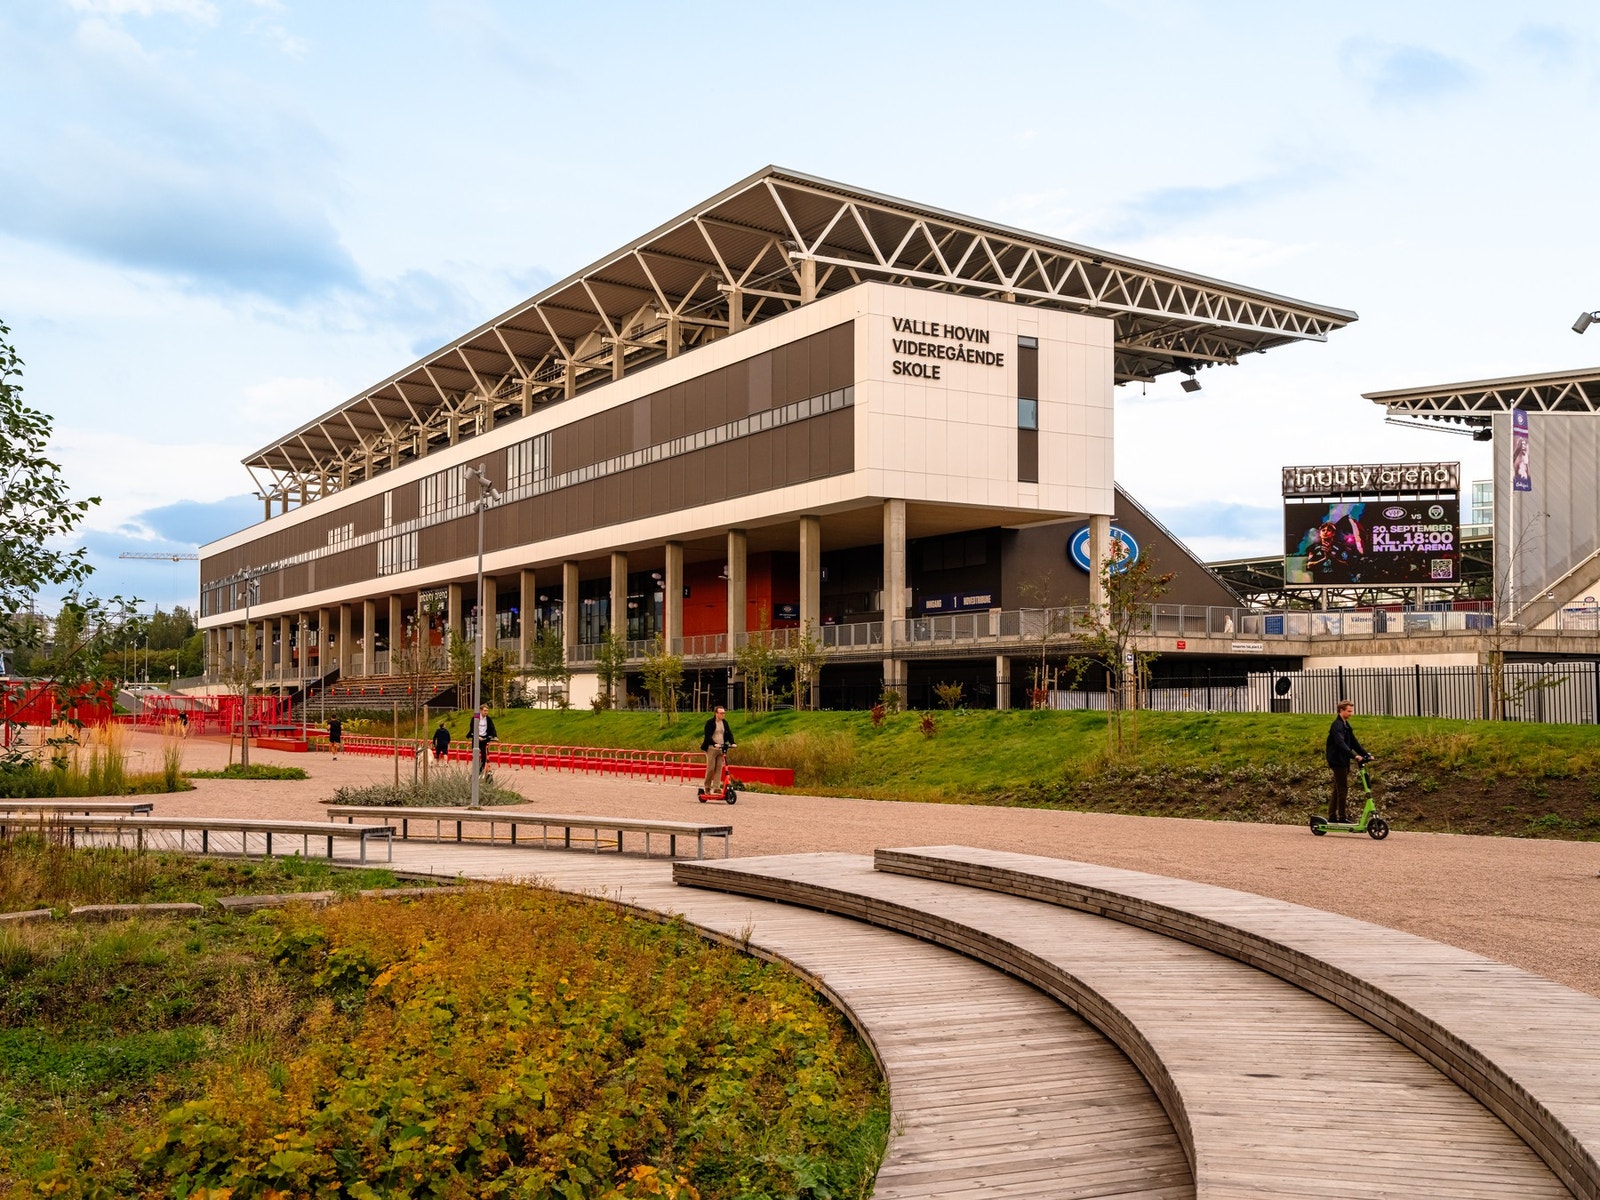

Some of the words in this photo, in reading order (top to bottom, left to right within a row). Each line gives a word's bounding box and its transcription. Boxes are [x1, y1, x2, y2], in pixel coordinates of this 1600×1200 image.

[892, 316, 940, 337] VALLE
[943, 324, 990, 344] HOVIN
[892, 338, 1005, 367] VIDEREGÅENDE
[892, 360, 941, 380] SKOLE
[1381, 468, 1449, 484] arena
[1390, 524, 1453, 533] SEPTEMBER
[1372, 533, 1400, 545] KL.
[1403, 532, 1454, 545] 18:00
[1372, 544, 1416, 552] INTILITY
[1417, 543, 1454, 552] ARENA
[953, 596, 957, 609] 1
